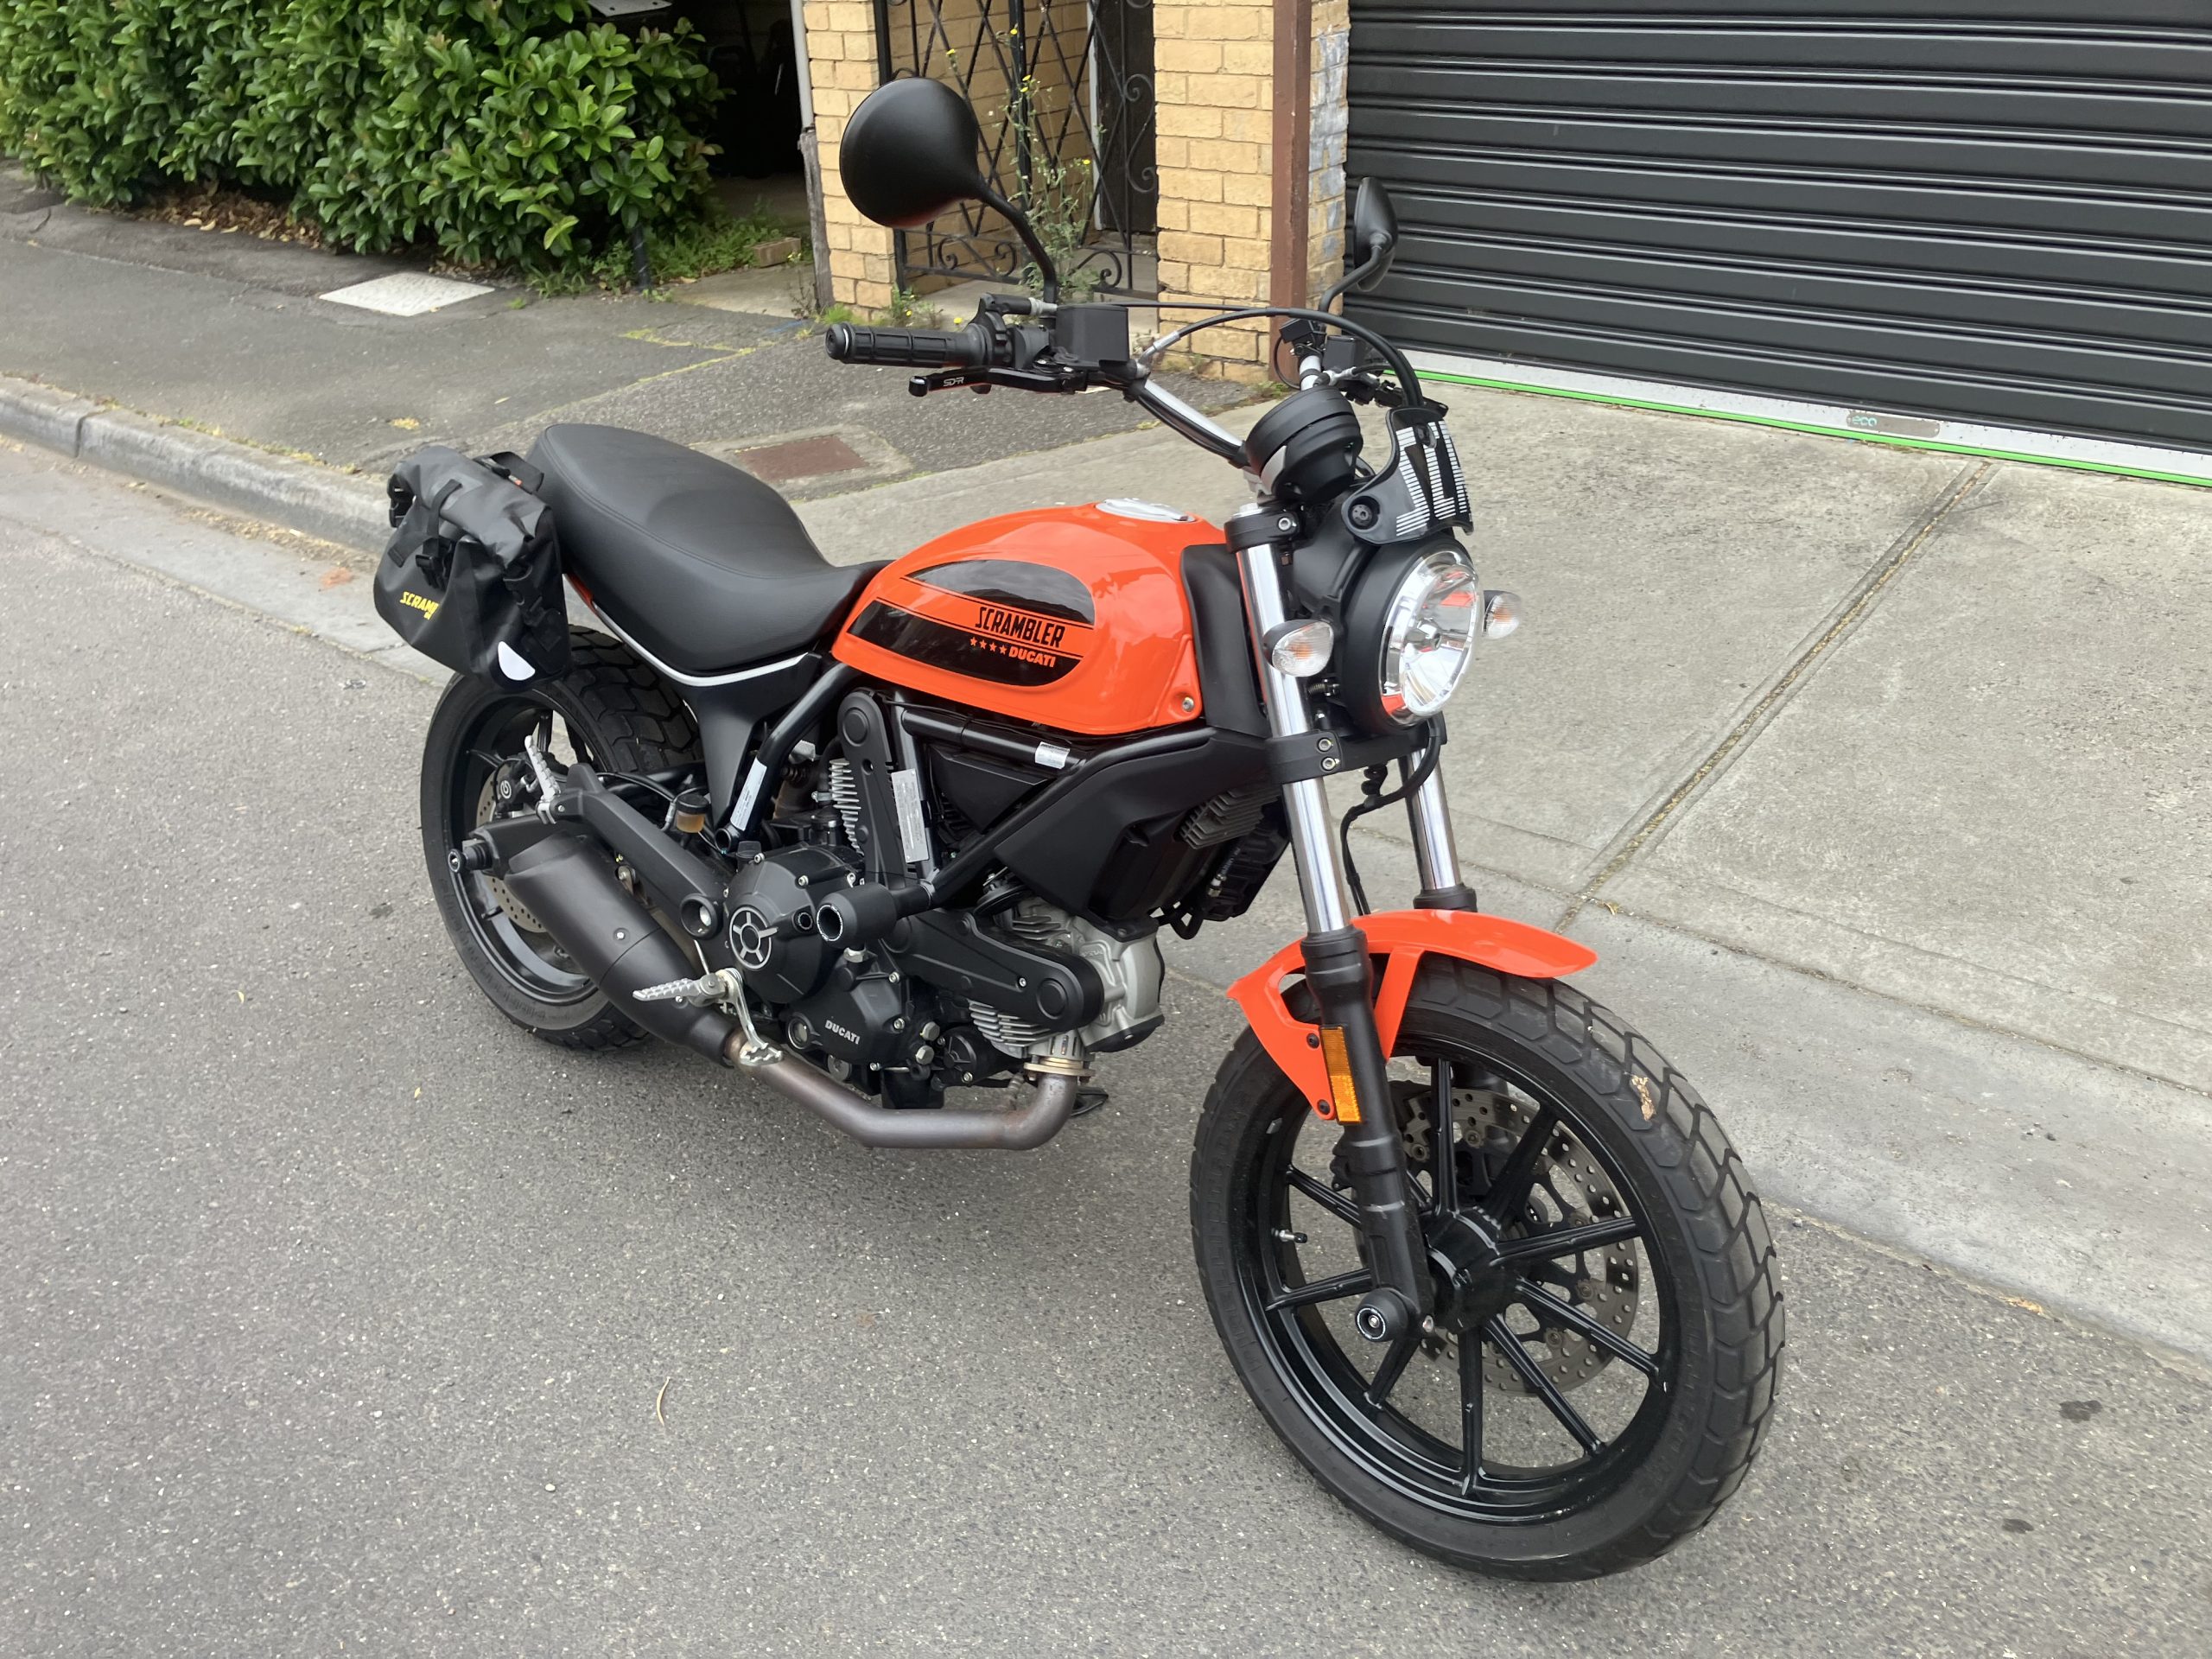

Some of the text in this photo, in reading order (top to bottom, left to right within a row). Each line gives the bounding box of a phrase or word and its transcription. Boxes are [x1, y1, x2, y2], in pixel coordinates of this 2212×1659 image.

[1852, 415, 1878, 427] eco
[975, 607, 1065, 648] SCRAMBLER
[1008, 645, 1056, 668] DUCATI
[824, 1020, 861, 1045] DUCATI
